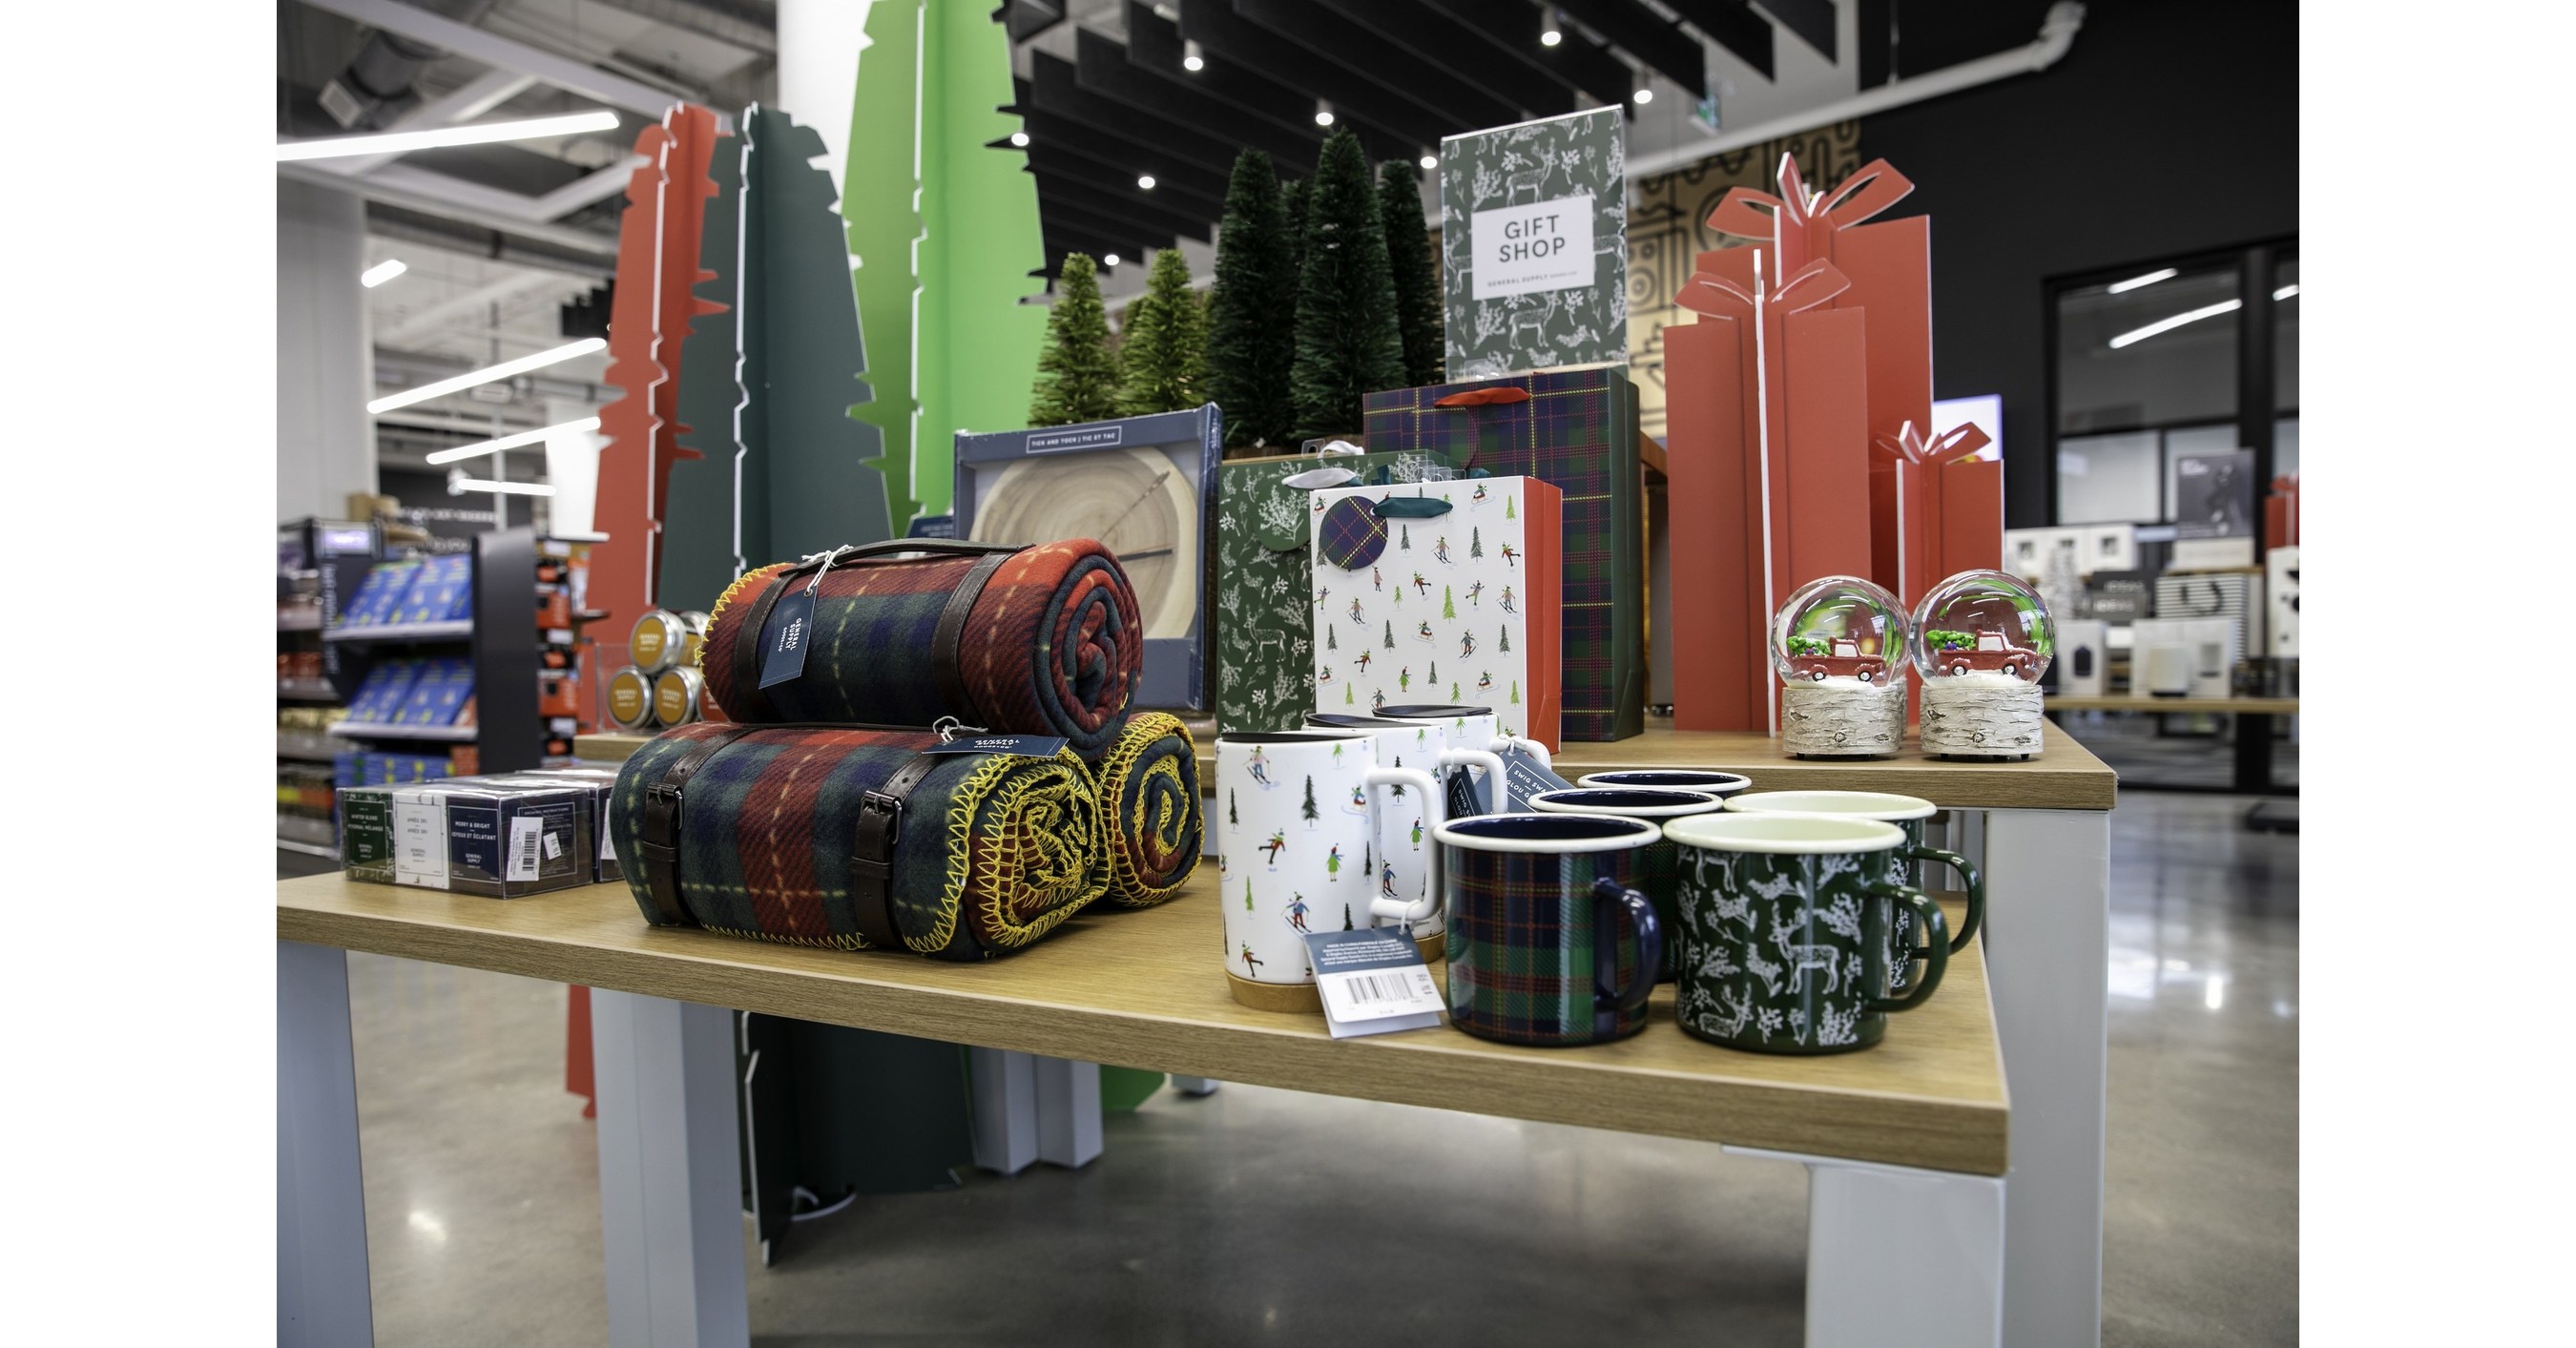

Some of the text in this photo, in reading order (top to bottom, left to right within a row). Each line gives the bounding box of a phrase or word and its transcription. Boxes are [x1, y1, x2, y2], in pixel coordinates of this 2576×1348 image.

[1505, 215, 1559, 239] GIFT
[1499, 237, 1566, 263] SHOP
[1487, 278, 1521, 287] GENERAL
[1522, 274, 1548, 283] SUPPLY
[2092, 598, 2135, 612] IDEAS
[785, 623, 796, 649] SUPPLY
[790, 617, 802, 651] GENERAL
[1506, 779, 1527, 795] GLOU
[1513, 769, 1547, 794] SWIG SWA
[473, 821, 490, 830] BRIGHT
[472, 832, 496, 840] ÉCLATANT
